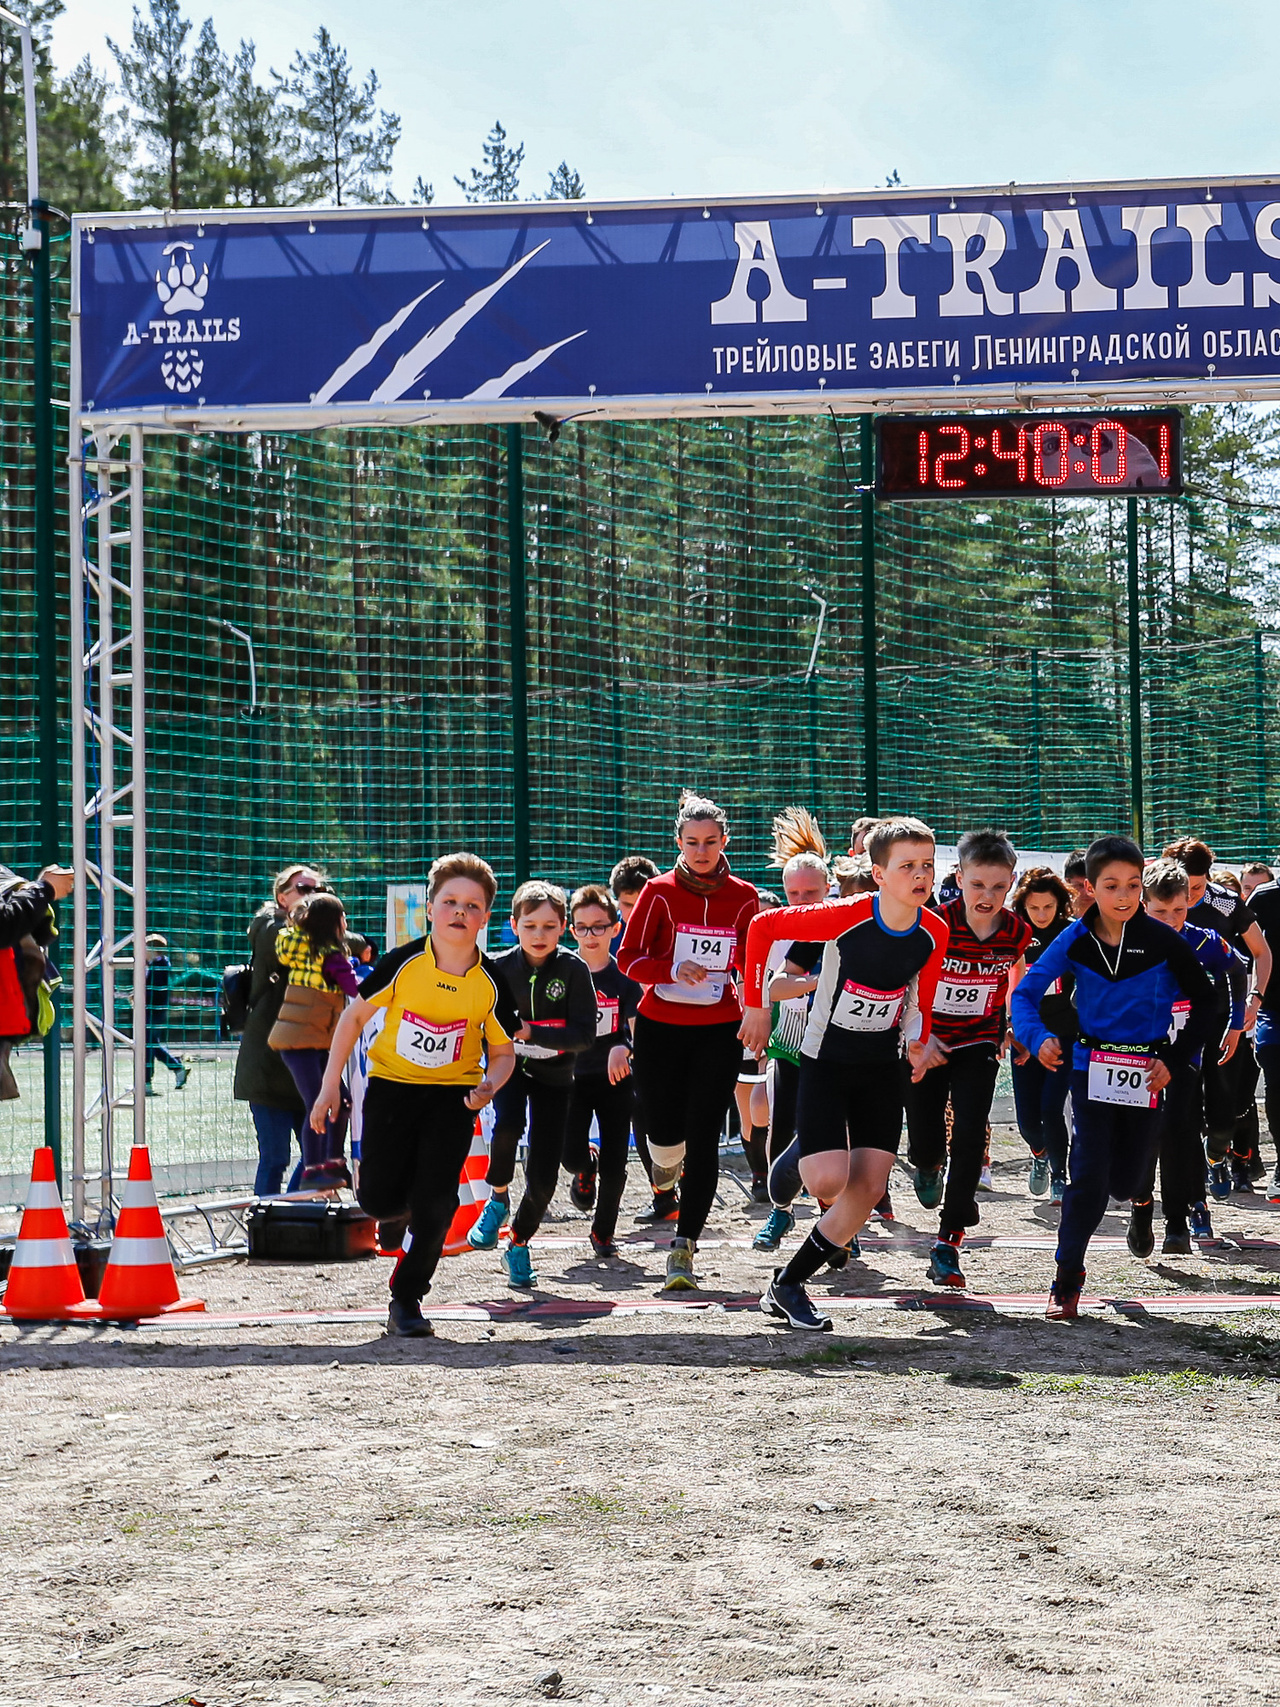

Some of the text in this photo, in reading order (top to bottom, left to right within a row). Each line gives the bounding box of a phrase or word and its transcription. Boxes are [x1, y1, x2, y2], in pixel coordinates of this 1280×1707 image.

[122, 317, 241, 346] A-TRAILS
[713, 338, 858, 374] ТРЕЙЛОВЫЕ
[868, 339, 961, 370] ЗАБЕГИ
[971, 324, 1190, 371] ЛЕНИНГРАДСКОЙ
[917, 421, 1170, 488] 12:40:01
[691, 938, 722, 956] 194
[436, 981, 457, 992] JAKO
[945, 986, 979, 1003] 198
[848, 999, 891, 1018] 214
[410, 1031, 447, 1053] 204
[1106, 1068, 1142, 1090] 190
